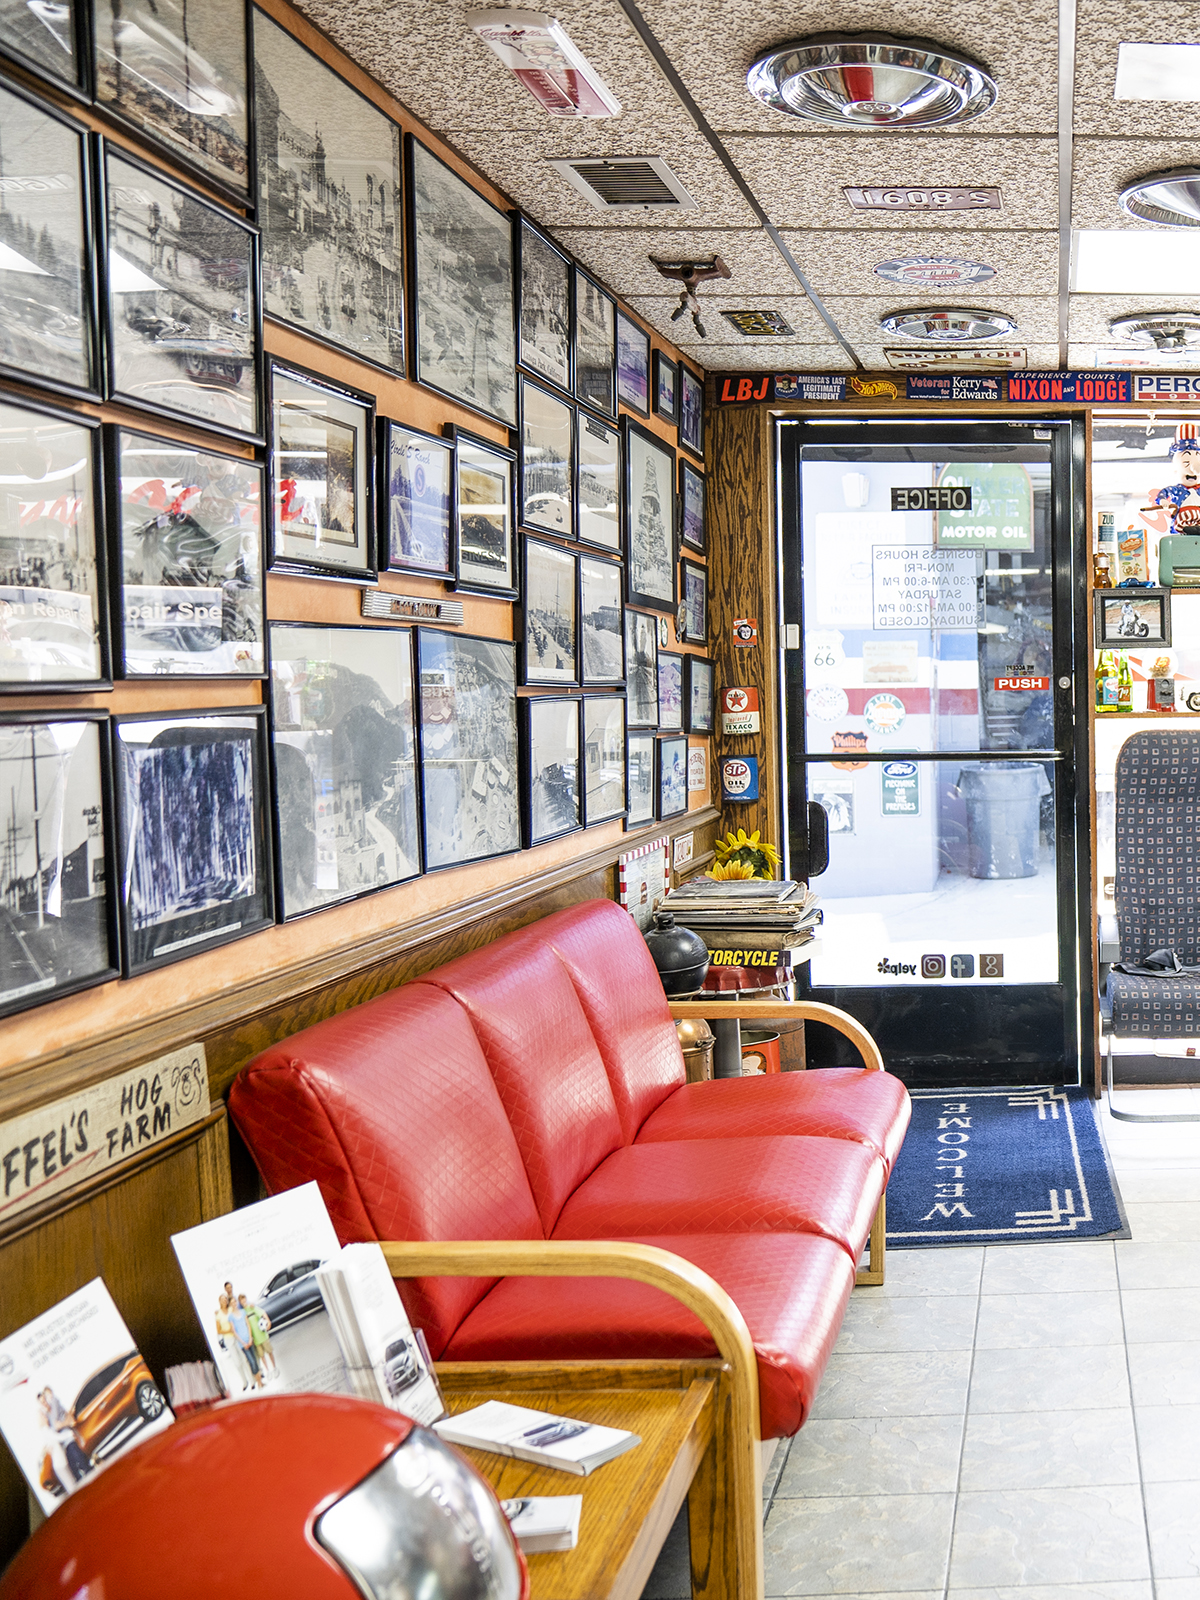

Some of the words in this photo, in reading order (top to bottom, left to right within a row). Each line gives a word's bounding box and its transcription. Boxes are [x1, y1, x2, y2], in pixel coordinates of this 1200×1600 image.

[892, 259, 978, 267] SERVICE
[881, 267, 982, 280] Buick
[798, 376, 830, 385] AMERICA'S
[831, 377, 847, 385] LAST
[910, 376, 951, 388] Veteran
[952, 376, 982, 391] Kerry
[721, 378, 770, 401] LBJ
[803, 384, 841, 393] LEGITIMATE
[861, 383, 875, 395] HOT
[952, 388, 998, 400] Edwards
[1009, 379, 1063, 400] NIXON
[1075, 380, 1127, 401] LODGE
[803, 391, 840, 400] PRESIDENT
[949, 498, 1020, 518] TATE
[1102, 514, 1115, 525] ZUD
[941, 526, 998, 538] MOTOR
[1001, 526, 1028, 538] OIL
[813, 653, 836, 667] 66
[998, 678, 1043, 689] PUSH
[725, 723, 753, 731] TEXACO
[833, 734, 867, 749] Phillips
[725, 764, 746, 776] STP
[886, 763, 914, 775] Ford
[707, 950, 780, 967] TORCYCLE
[120, 1073, 163, 1117] HOG
[105, 1101, 172, 1159] FARM
[920, 1102, 976, 1222] WELCOME
